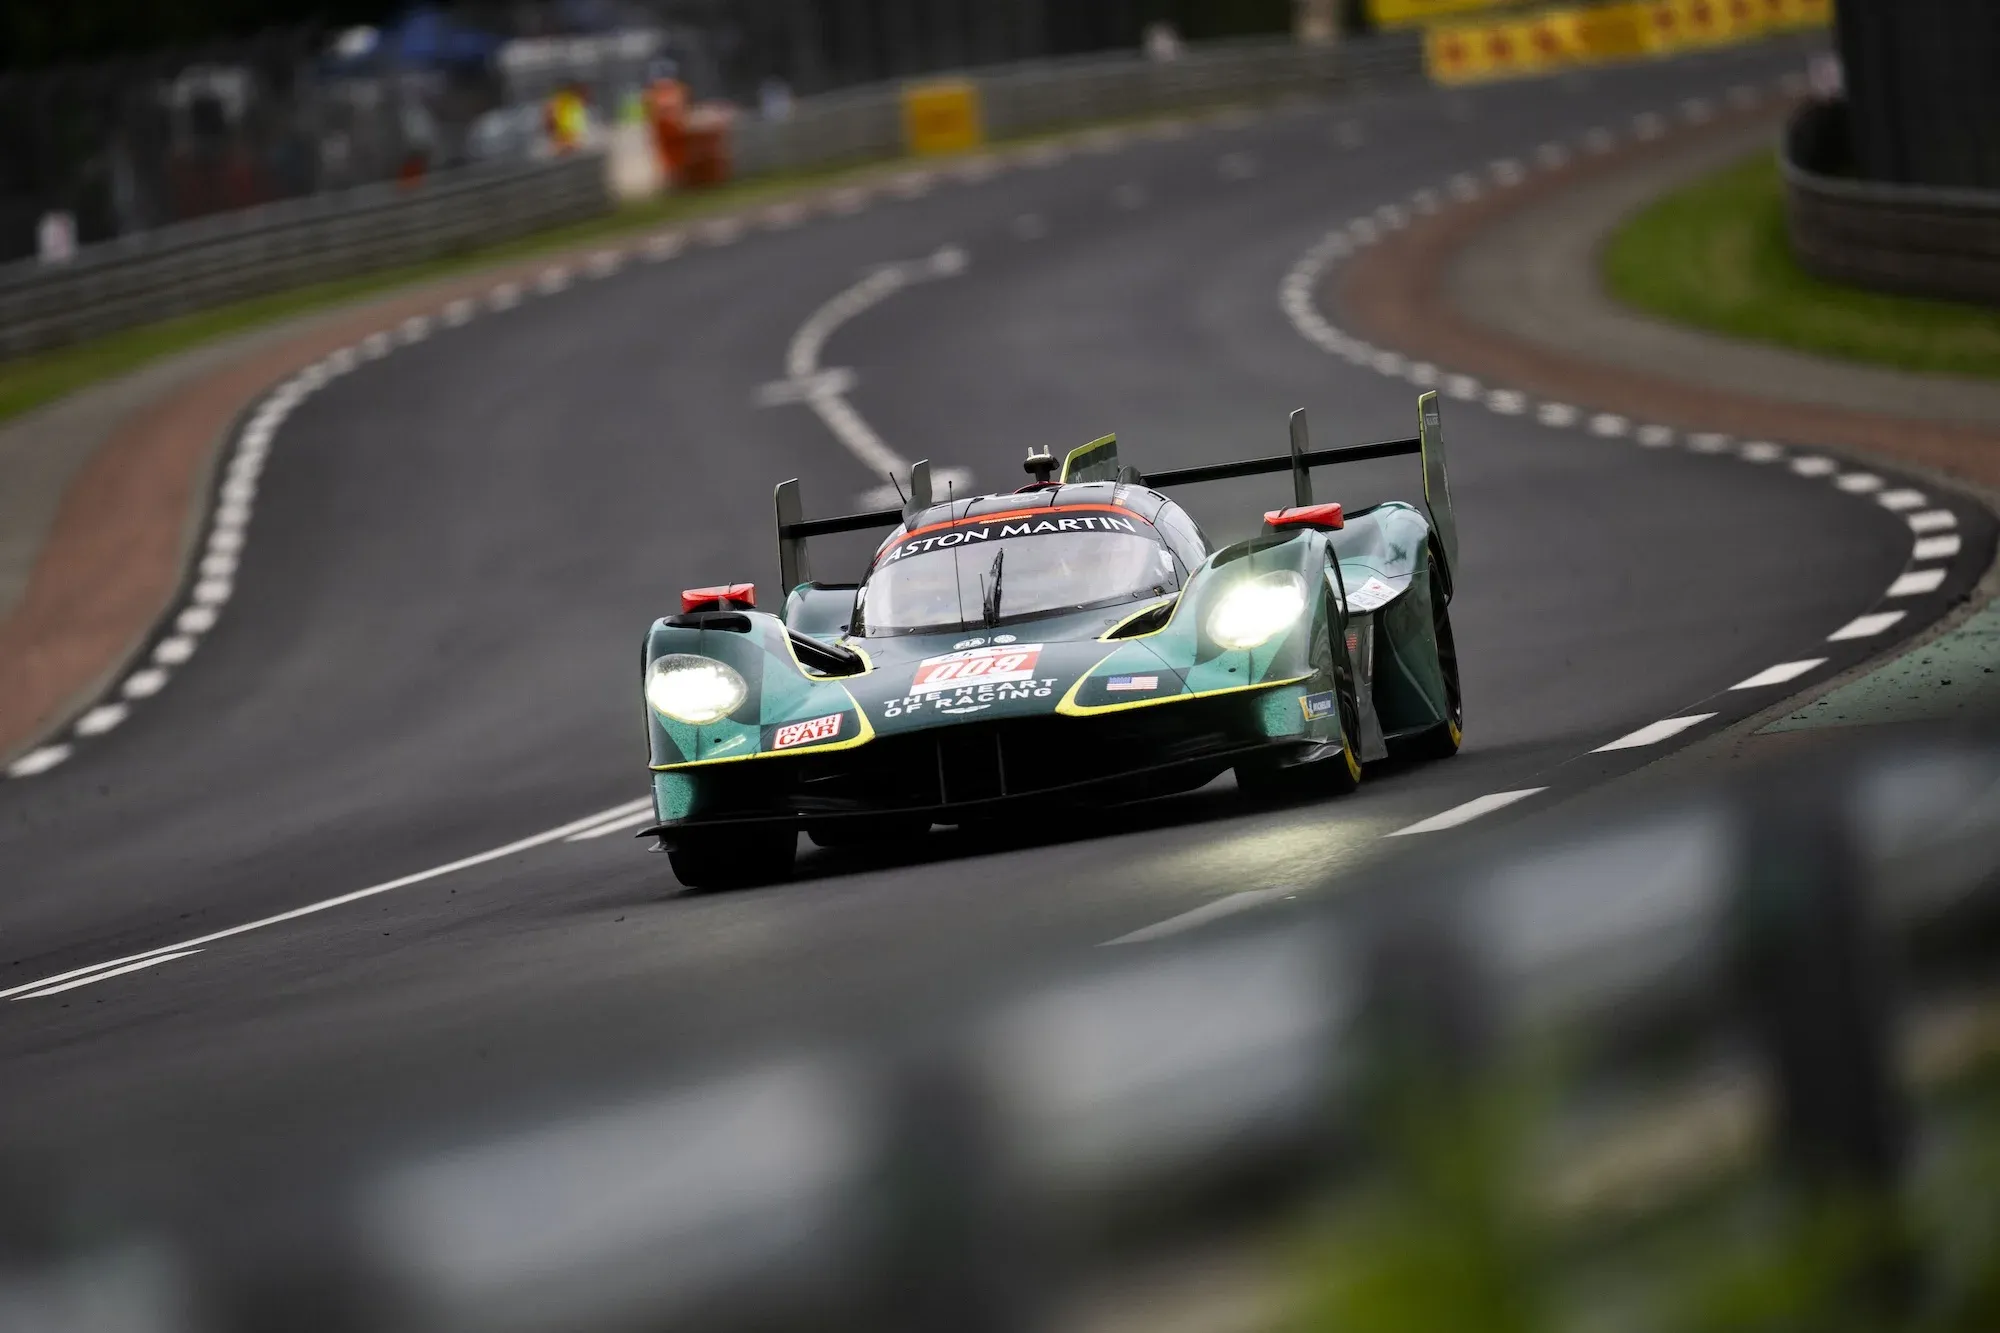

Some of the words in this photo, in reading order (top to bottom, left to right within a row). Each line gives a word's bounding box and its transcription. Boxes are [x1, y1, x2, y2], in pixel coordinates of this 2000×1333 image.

[883, 527, 990, 566] ASTON
[1000, 516, 1137, 538] MARTIN
[923, 653, 1029, 684] 009
[884, 691, 942, 709] THE
[955, 678, 1058, 697] HEART
[884, 703, 922, 718] OF
[935, 687, 1052, 709] RACING
[779, 723, 834, 745] CAR
[780, 716, 836, 735] HYPER
